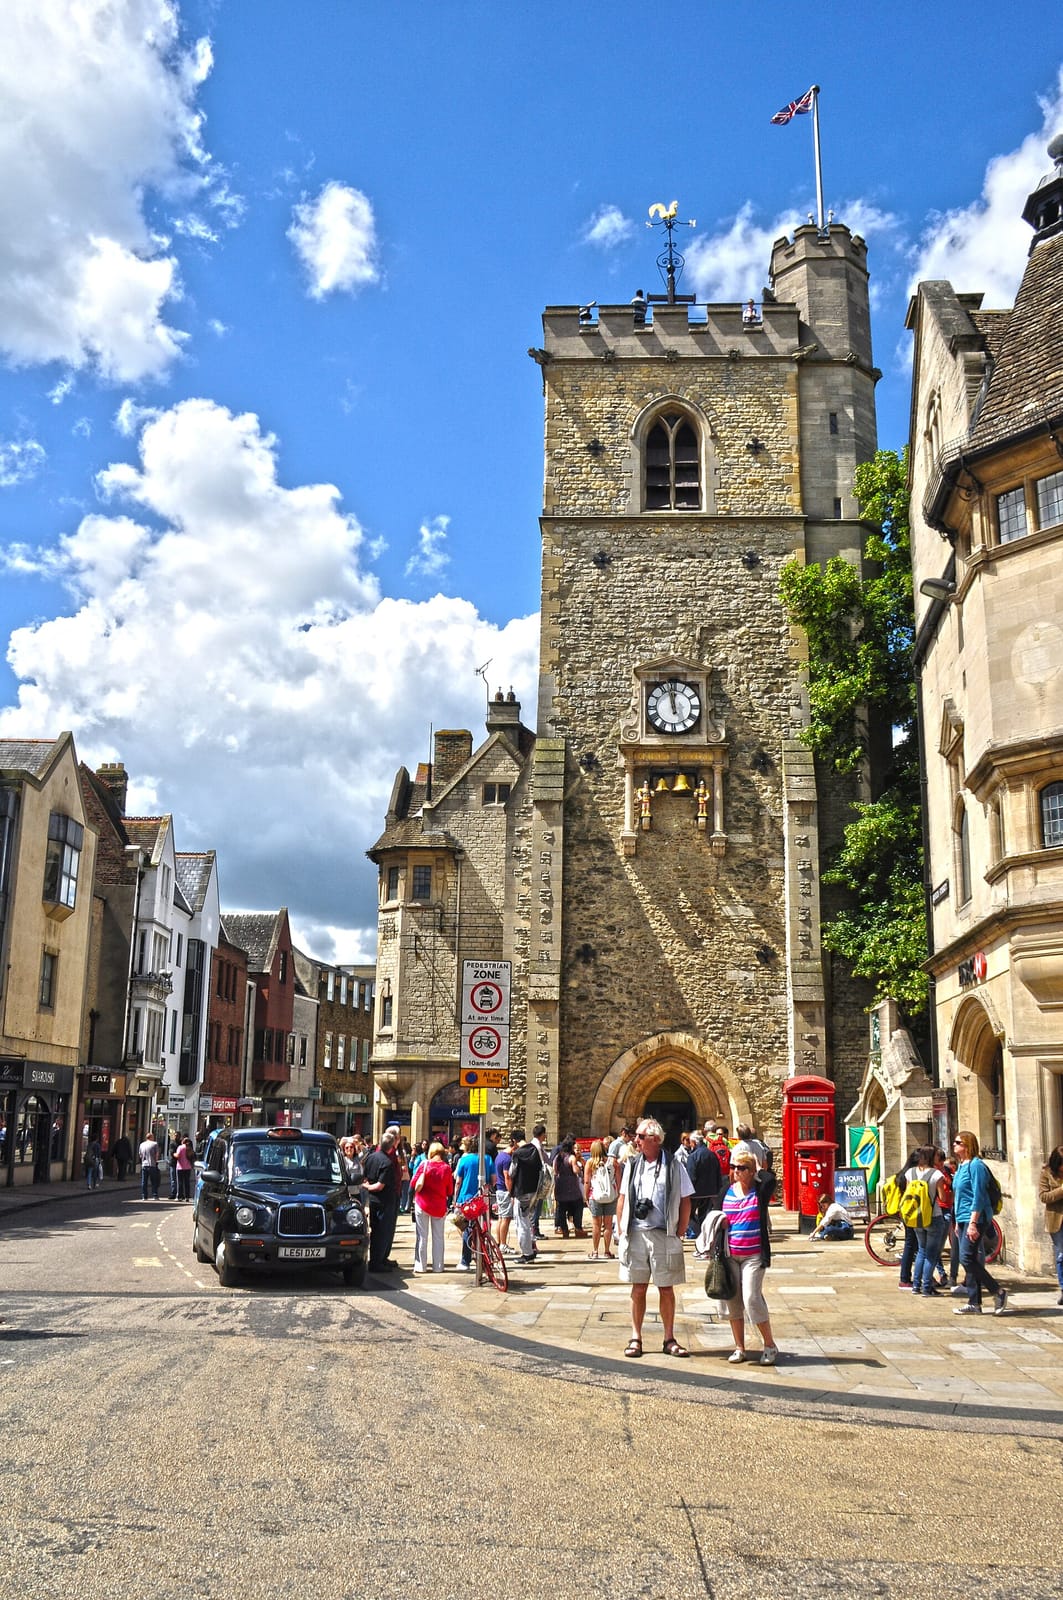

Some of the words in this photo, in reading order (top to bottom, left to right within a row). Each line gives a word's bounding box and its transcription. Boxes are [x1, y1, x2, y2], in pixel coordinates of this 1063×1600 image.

[473, 970, 501, 979] ZONE
[844, 1175, 864, 1183] HOUR
[305, 1248, 321, 1257] DXZ
